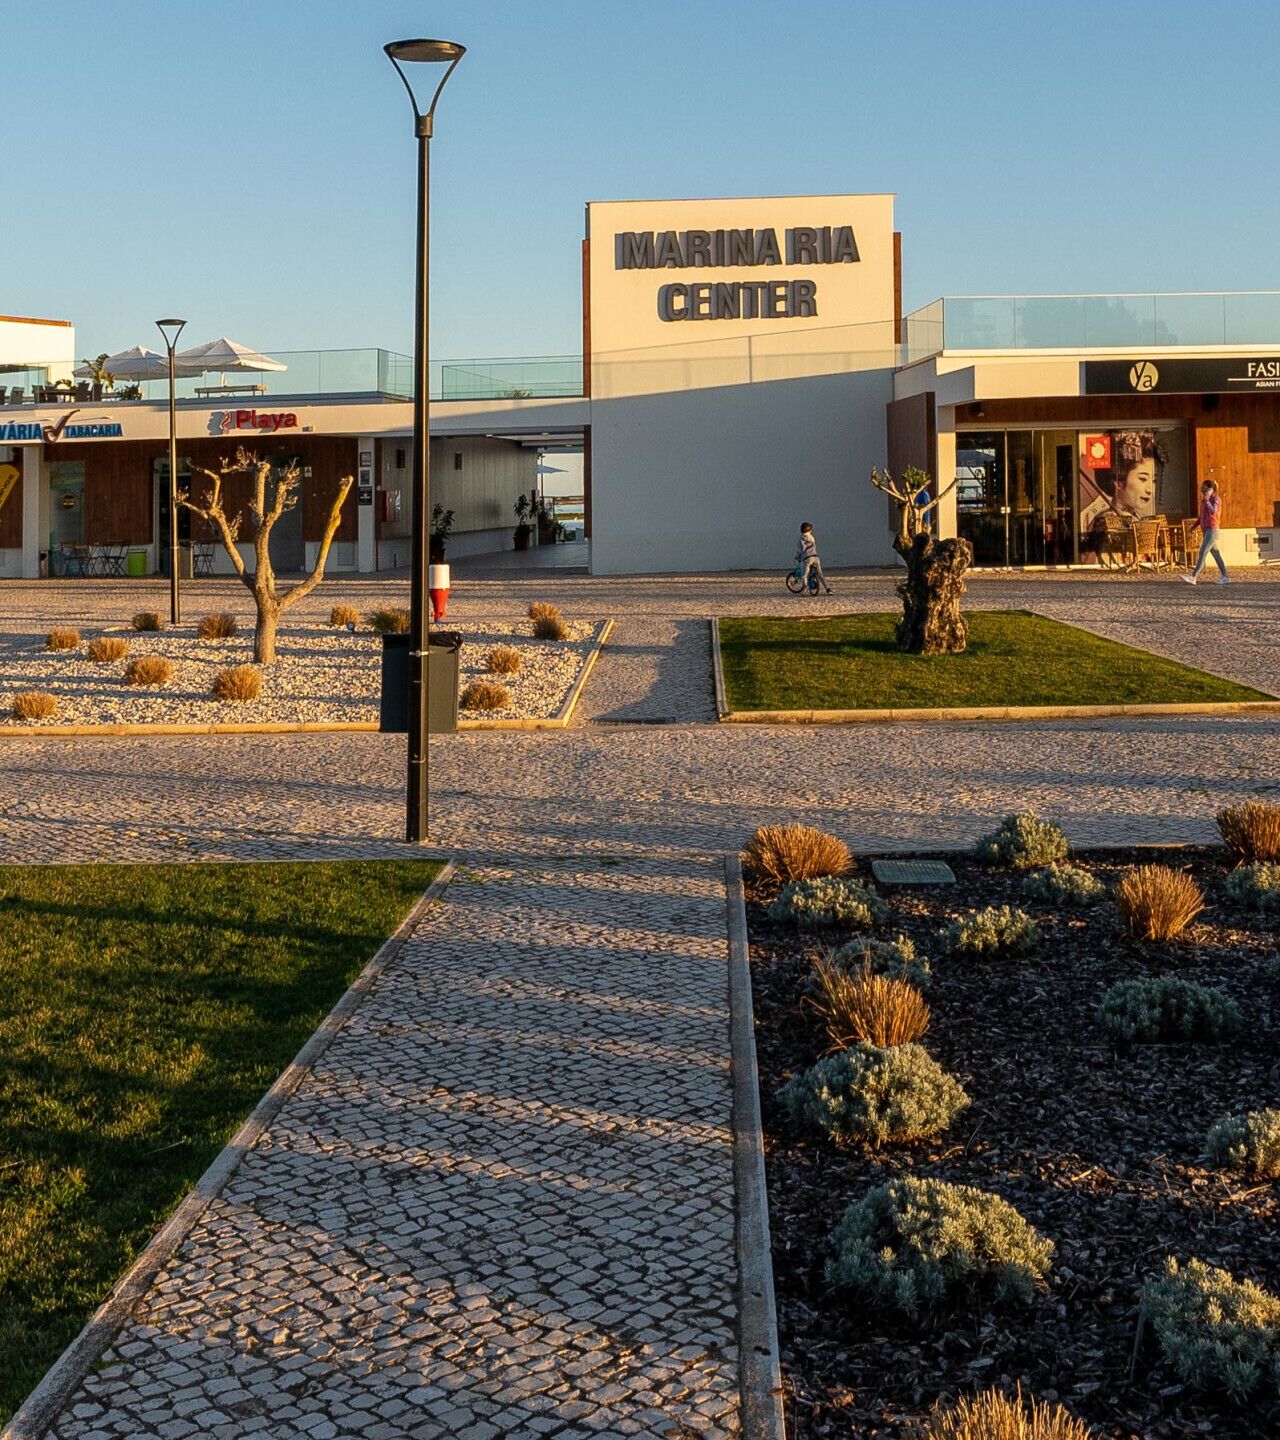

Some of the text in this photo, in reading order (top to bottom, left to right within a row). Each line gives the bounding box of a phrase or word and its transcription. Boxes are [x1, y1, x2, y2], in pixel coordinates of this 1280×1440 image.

[619, 226, 861, 270] MARINA RIA
[657, 280, 819, 322] CENTER
[1255, 380, 1275, 388] ASIAN
[64, 424, 123, 438] TABACARIA
[236, 410, 298, 432] Playa
